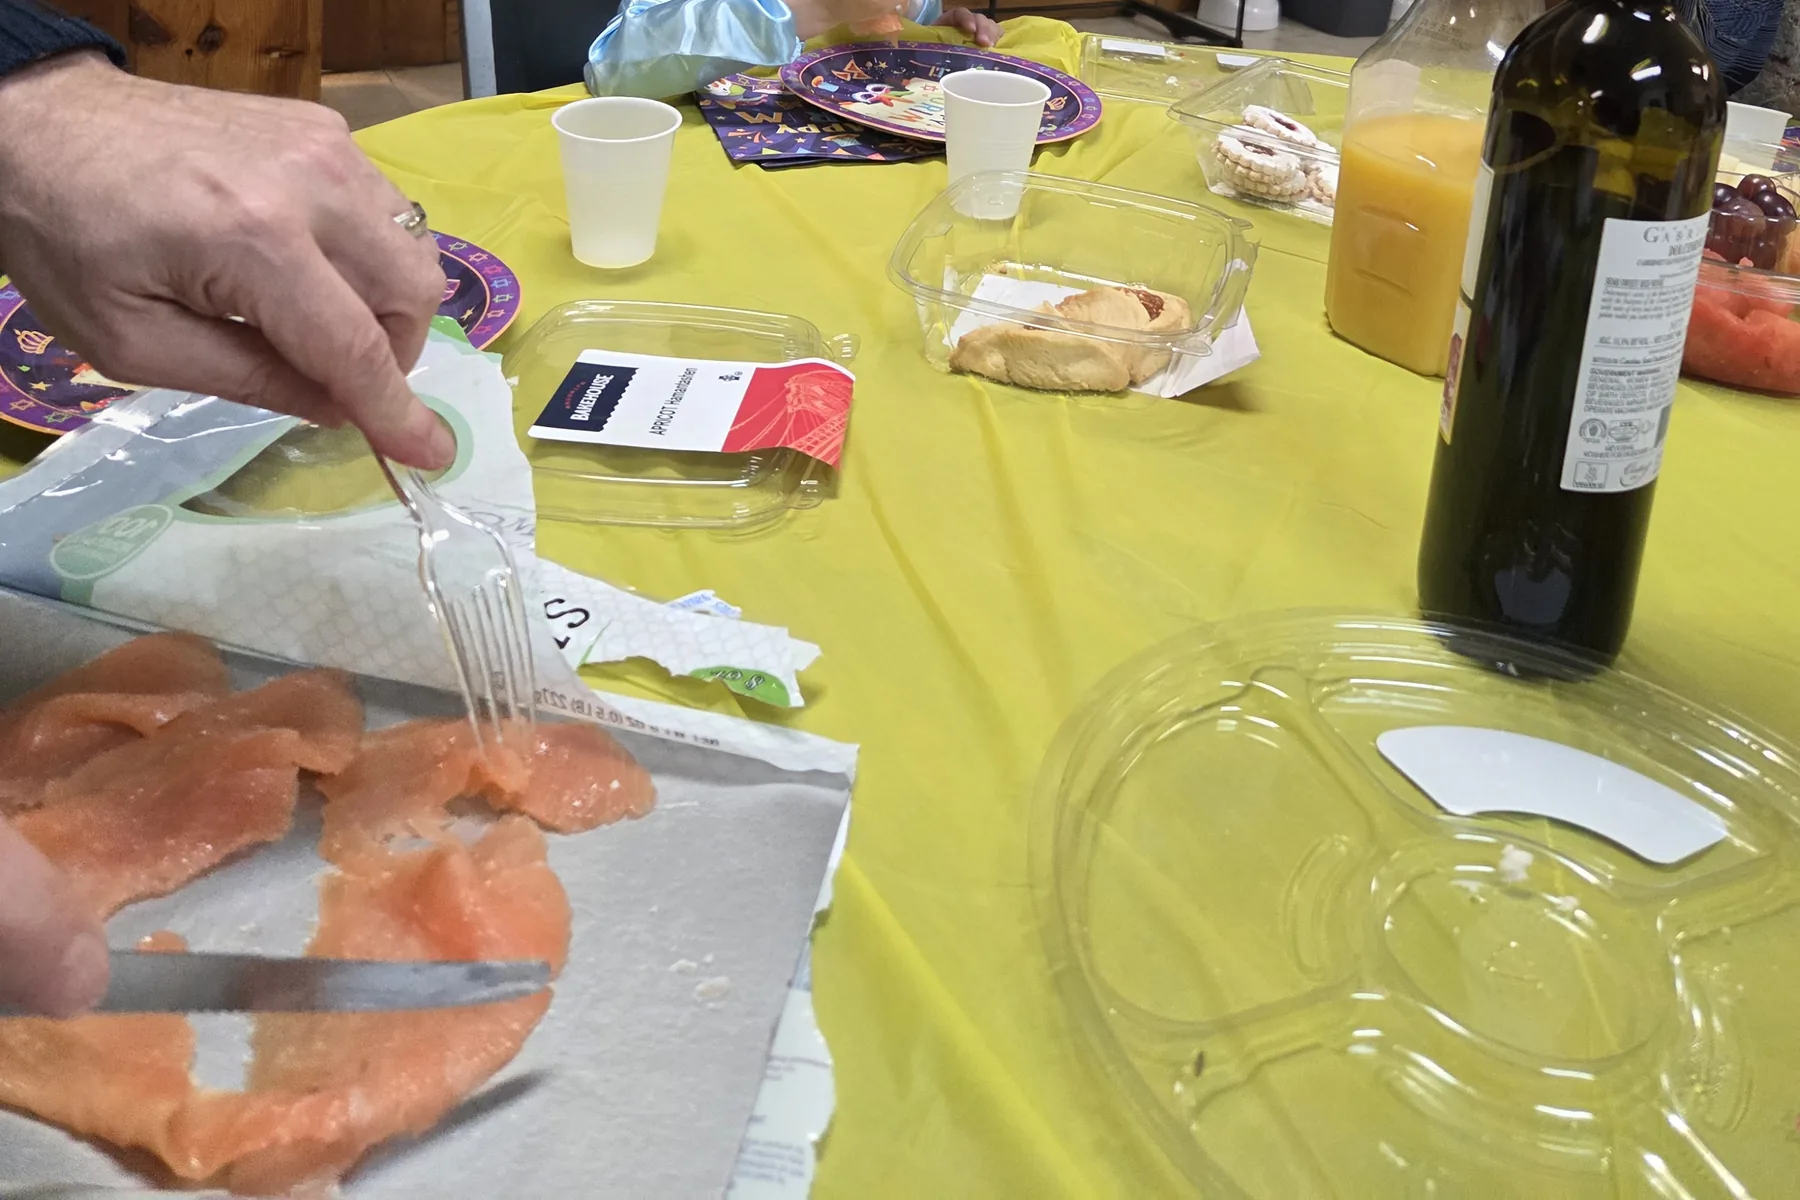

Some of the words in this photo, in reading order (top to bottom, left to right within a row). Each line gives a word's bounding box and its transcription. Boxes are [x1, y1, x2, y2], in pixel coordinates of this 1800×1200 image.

[569, 373, 615, 421] BAKEHOUSE
[664, 367, 698, 406] Hamantashen
[649, 405, 678, 436] APRICOT
